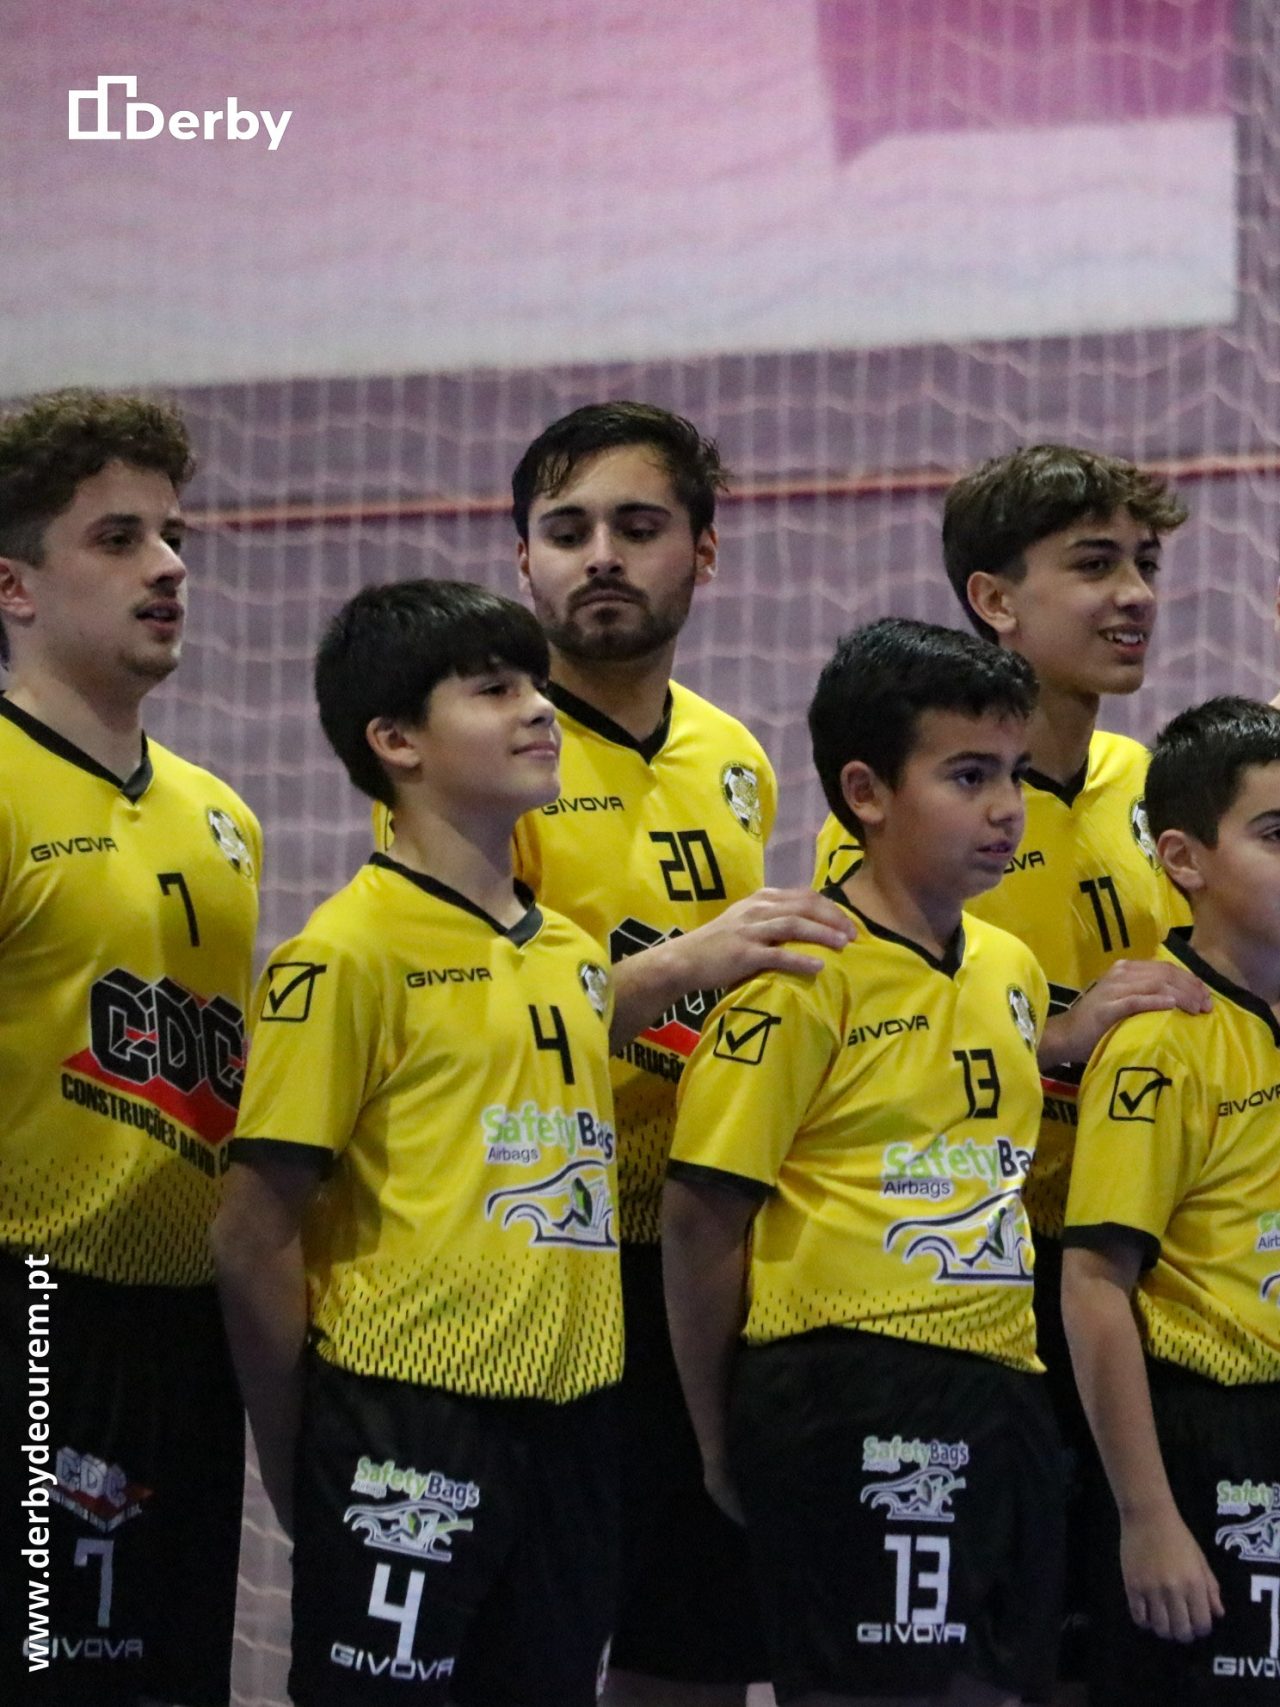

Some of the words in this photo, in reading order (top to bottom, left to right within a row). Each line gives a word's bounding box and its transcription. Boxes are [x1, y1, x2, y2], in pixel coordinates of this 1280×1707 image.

[541, 796, 625, 816] GIVOVA
[30, 836, 118, 862] GIVOVA
[649, 829, 727, 901] 20
[157, 872, 200, 947] 7
[1079, 875, 1130, 952] 11
[407, 967, 493, 988] GIVOVA
[528, 1004, 575, 1085] 4
[847, 1015, 930, 1046] GIVOVA
[61, 1072, 178, 1152] CONSTRUÇÕES
[952, 1049, 1000, 1119] 13
[488, 1146, 539, 1162] Airbags
[883, 1179, 951, 1198] Airbags
[885, 1139, 1034, 1188] SafetyBa
[74, 1538, 114, 1628] 7
[367, 1562, 426, 1664] 4
[884, 1534, 950, 1624] 13
[857, 1622, 967, 1644] GIVOVA
[1250, 1574, 1280, 1659] 7
[331, 1642, 455, 1681] GIVOVA
